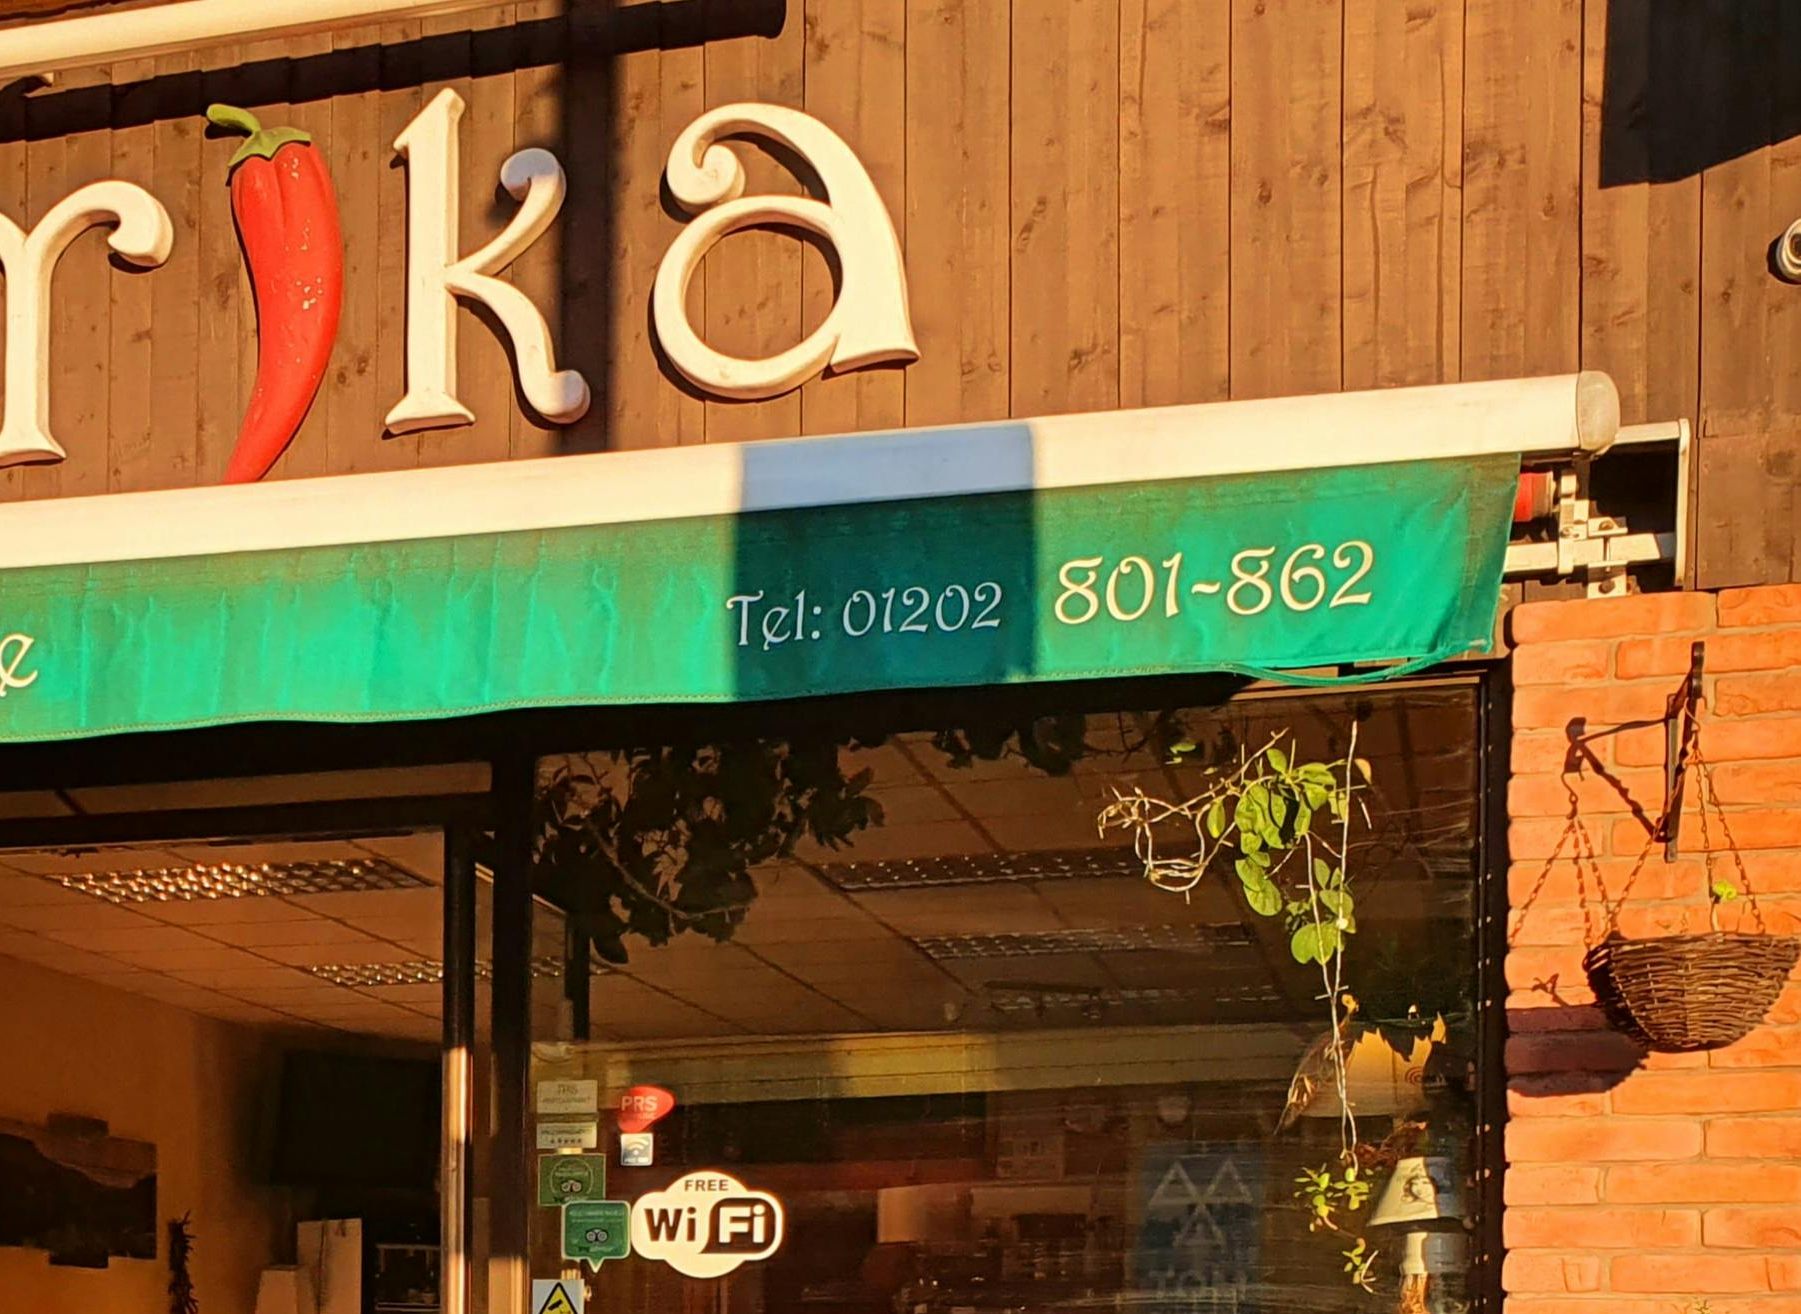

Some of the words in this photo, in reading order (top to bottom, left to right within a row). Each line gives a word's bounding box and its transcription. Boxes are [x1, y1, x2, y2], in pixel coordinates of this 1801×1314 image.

[842, 581, 1004, 637] 01202
[1054, 540, 1375, 626] 801-862
[621, 1095, 658, 1113] PRS
[684, 1179, 729, 1192] FREE
